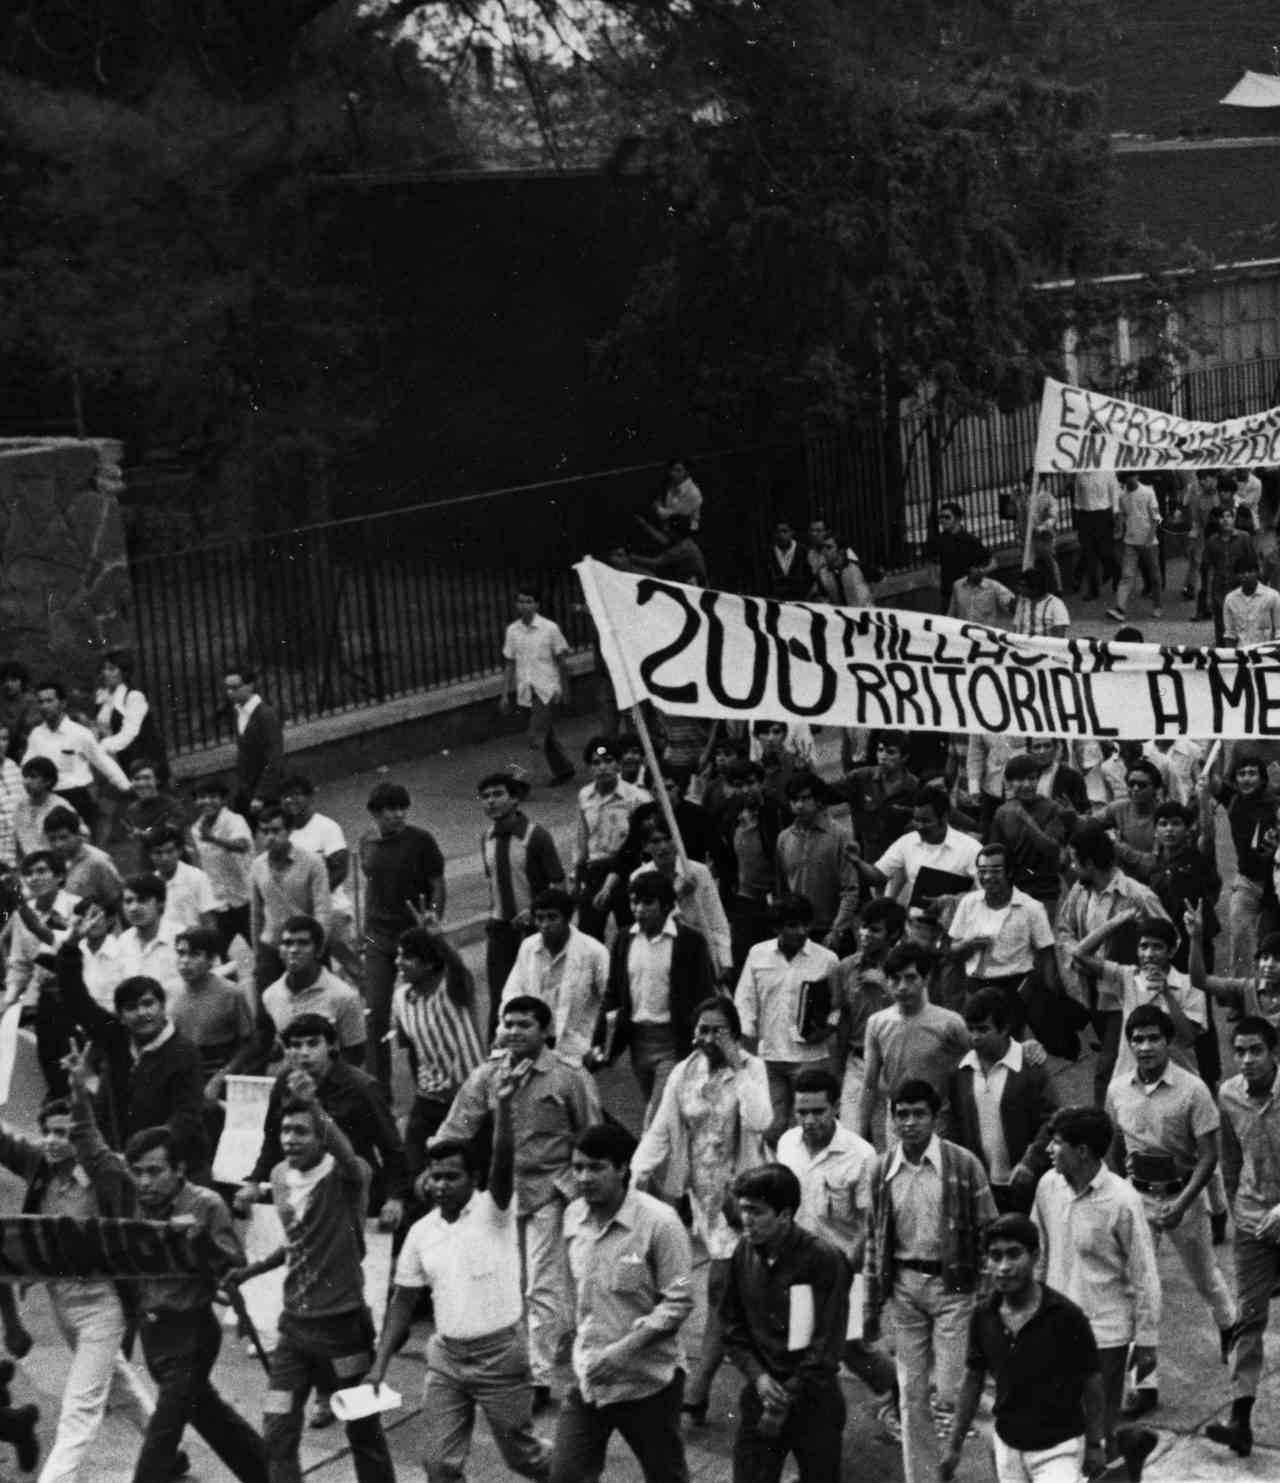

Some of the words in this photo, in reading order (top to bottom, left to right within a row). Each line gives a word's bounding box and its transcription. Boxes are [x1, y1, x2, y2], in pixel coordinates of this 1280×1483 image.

[1052, 431, 1106, 471] SIN
[635, 577, 839, 717] 200
[847, 660, 1119, 737] RRITORIAL
[1146, 669, 1188, 735] A
